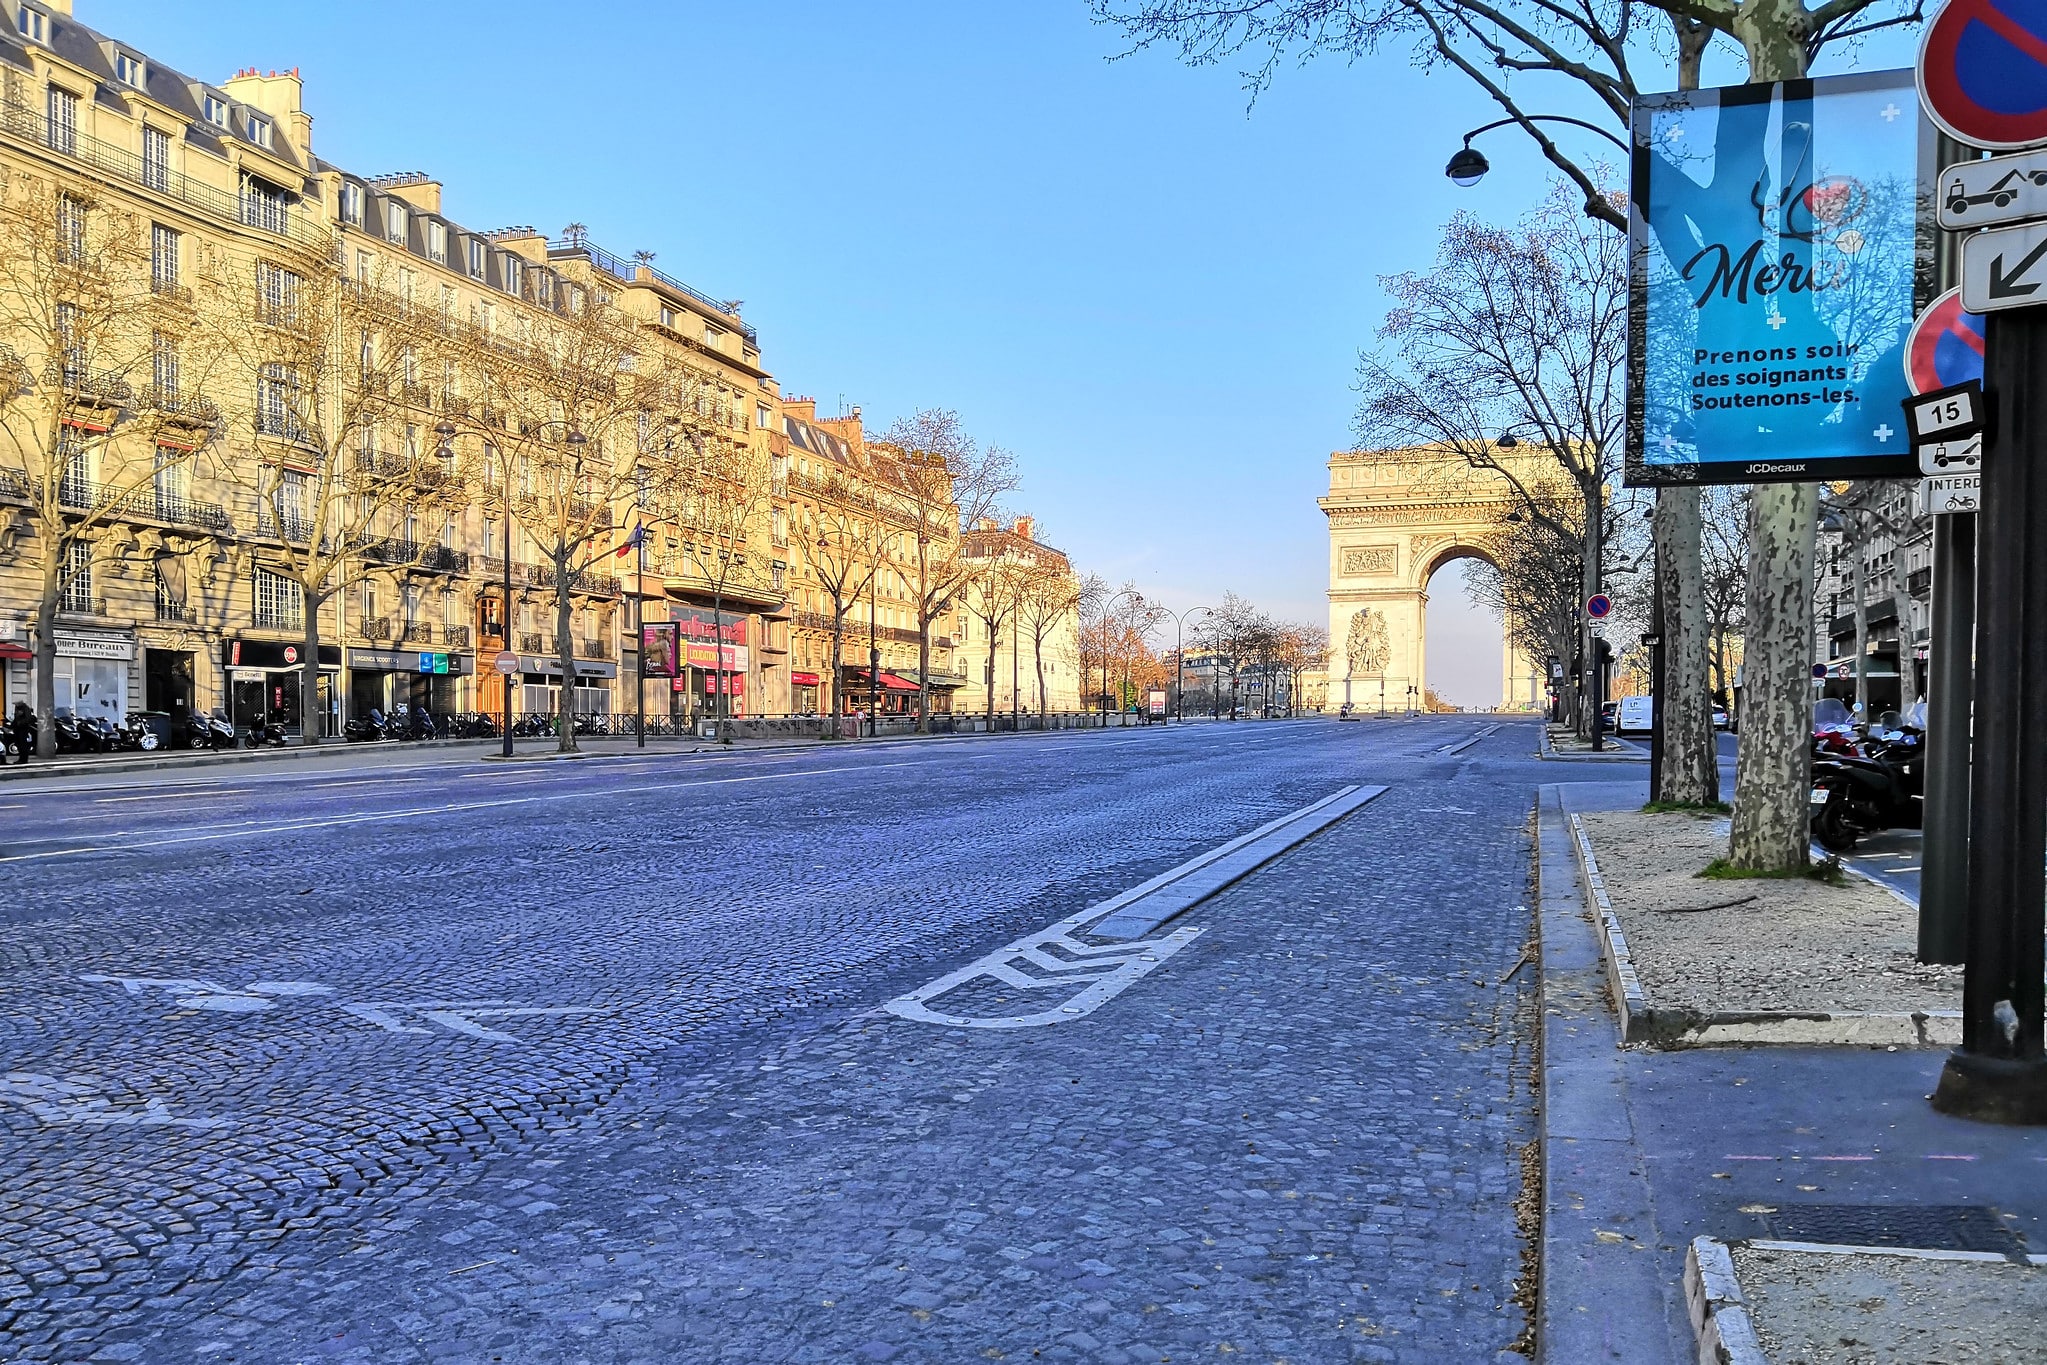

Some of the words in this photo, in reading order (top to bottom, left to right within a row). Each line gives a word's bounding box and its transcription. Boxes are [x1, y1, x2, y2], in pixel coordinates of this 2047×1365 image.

[1681, 239, 1849, 308] Merci
[1694, 346, 1797, 366] Prenons
[1806, 340, 1859, 360] soin
[1692, 371, 1730, 388] des
[1735, 365, 1846, 388] soignants
[1692, 387, 1860, 411] Soutenons-les.
[1931, 401, 1960, 424] 15
[1745, 463, 1806, 474] JCDecaux
[1929, 478, 1981, 492] INTERD
[57, 640, 76, 648] ouer
[79, 640, 125, 651] Bureaux
